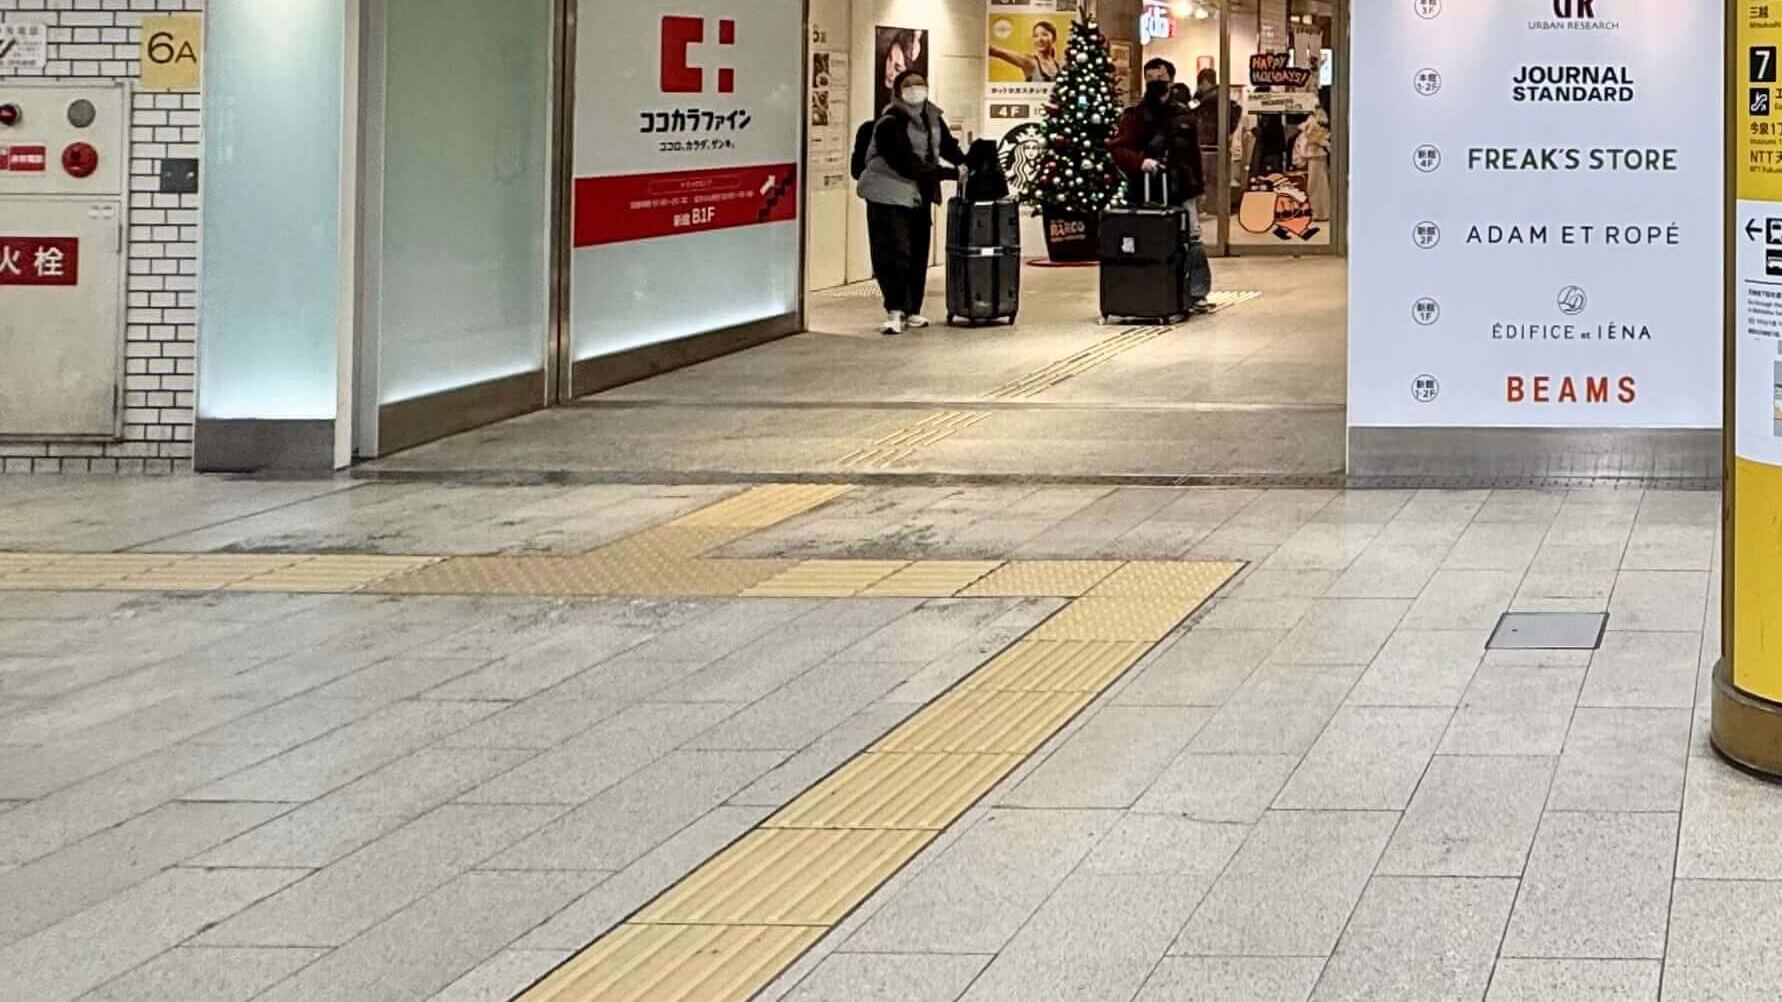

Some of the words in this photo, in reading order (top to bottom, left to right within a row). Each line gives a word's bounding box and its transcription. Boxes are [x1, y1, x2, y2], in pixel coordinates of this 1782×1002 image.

[1528, 21, 1565, 30] URBAN
[1567, 21, 1620, 30] RESEARCH
[148, 31, 198, 65] 6A
[1251, 56, 1289, 71] HAPPY
[1754, 50, 1771, 80] 7
[1512, 65, 1634, 85] JOURNAL
[1512, 85, 1635, 103] STANDARD
[639, 108, 752, 133] ココカラファイン
[998, 105, 1021, 118] 4F
[1419, 159, 1434, 168] 4F
[1588, 148, 1678, 171] STORE
[691, 206, 717, 225] B1F
[1419, 235, 1434, 245] 2F
[1465, 225, 1548, 244] ADAM
[1561, 225, 1594, 244] ET
[1605, 222, 1681, 245] ROPÉ
[1419, 312, 1434, 322] 1F
[1491, 321, 1576, 340] ÉDIFICE
[1580, 331, 1592, 340] et
[1597, 321, 1652, 340] IÉNA
[1506, 375, 1637, 403] BEAMS
